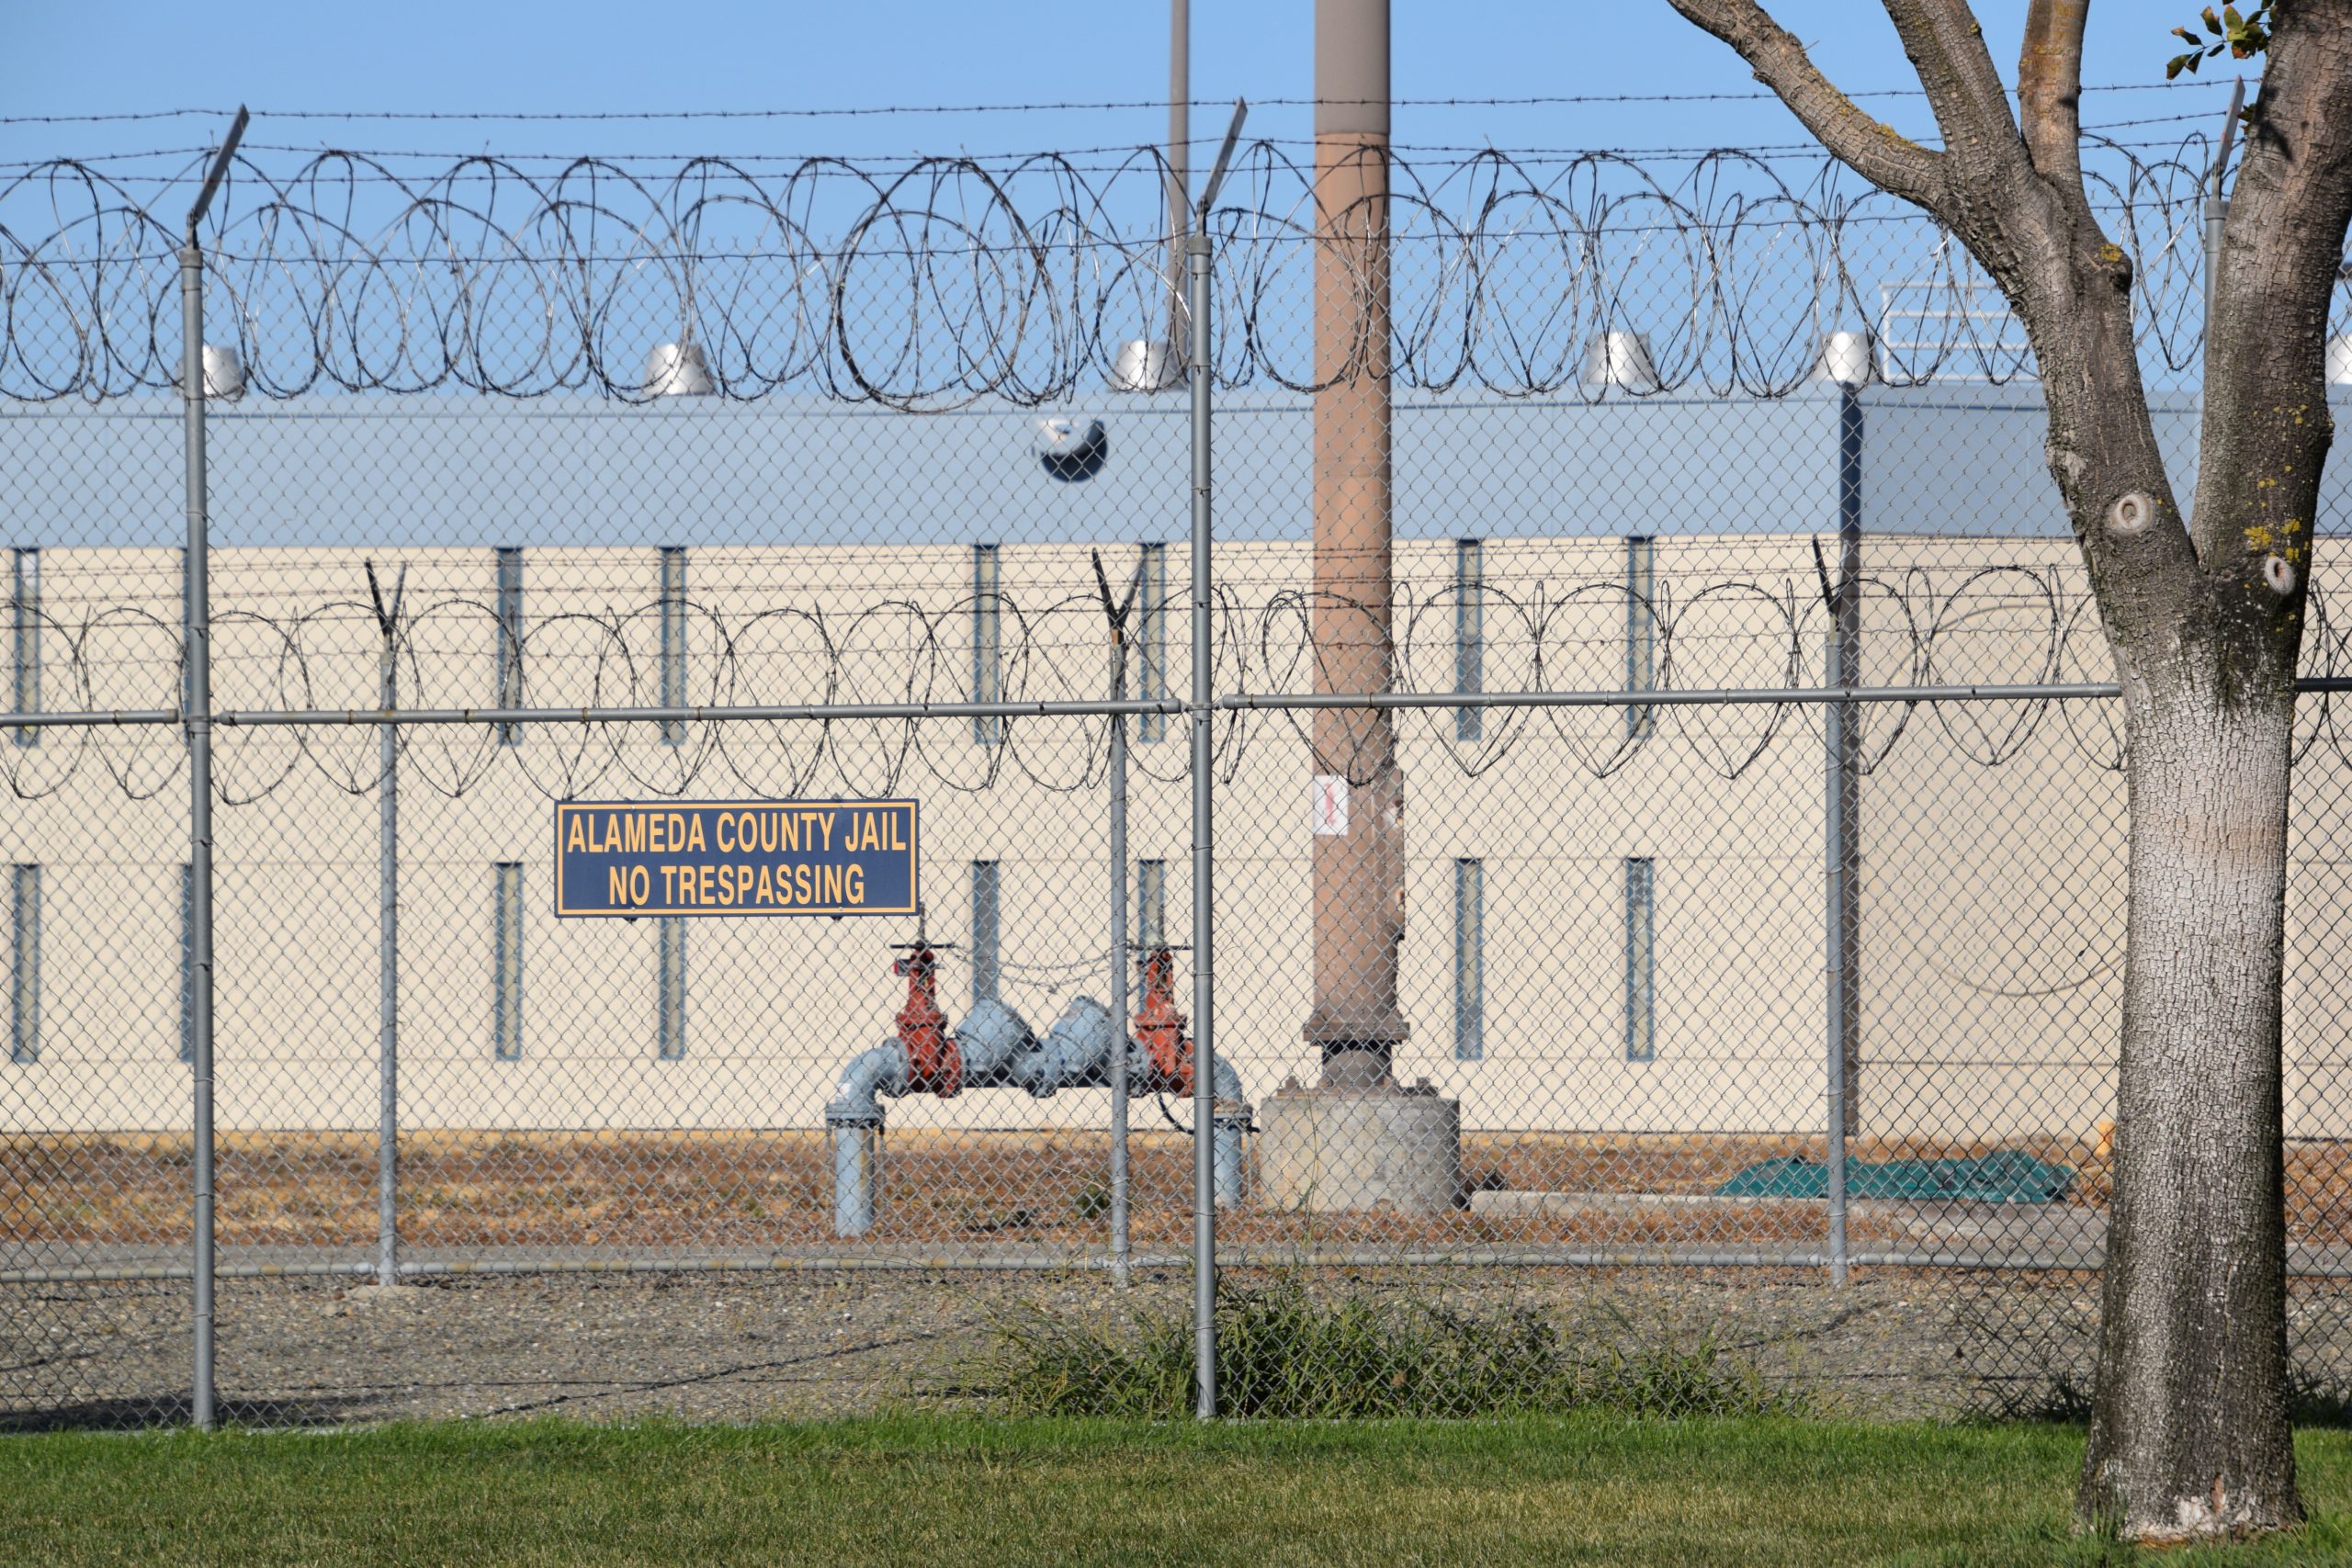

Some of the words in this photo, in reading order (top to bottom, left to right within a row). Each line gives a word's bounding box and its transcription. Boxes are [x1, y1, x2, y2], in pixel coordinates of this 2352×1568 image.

[567, 813, 707, 853] ALAMEDA
[717, 812, 835, 852] COUNTY
[844, 812, 906, 852] JAIL
[609, 865, 650, 905] NO
[661, 863, 865, 905] TRESPASSING
